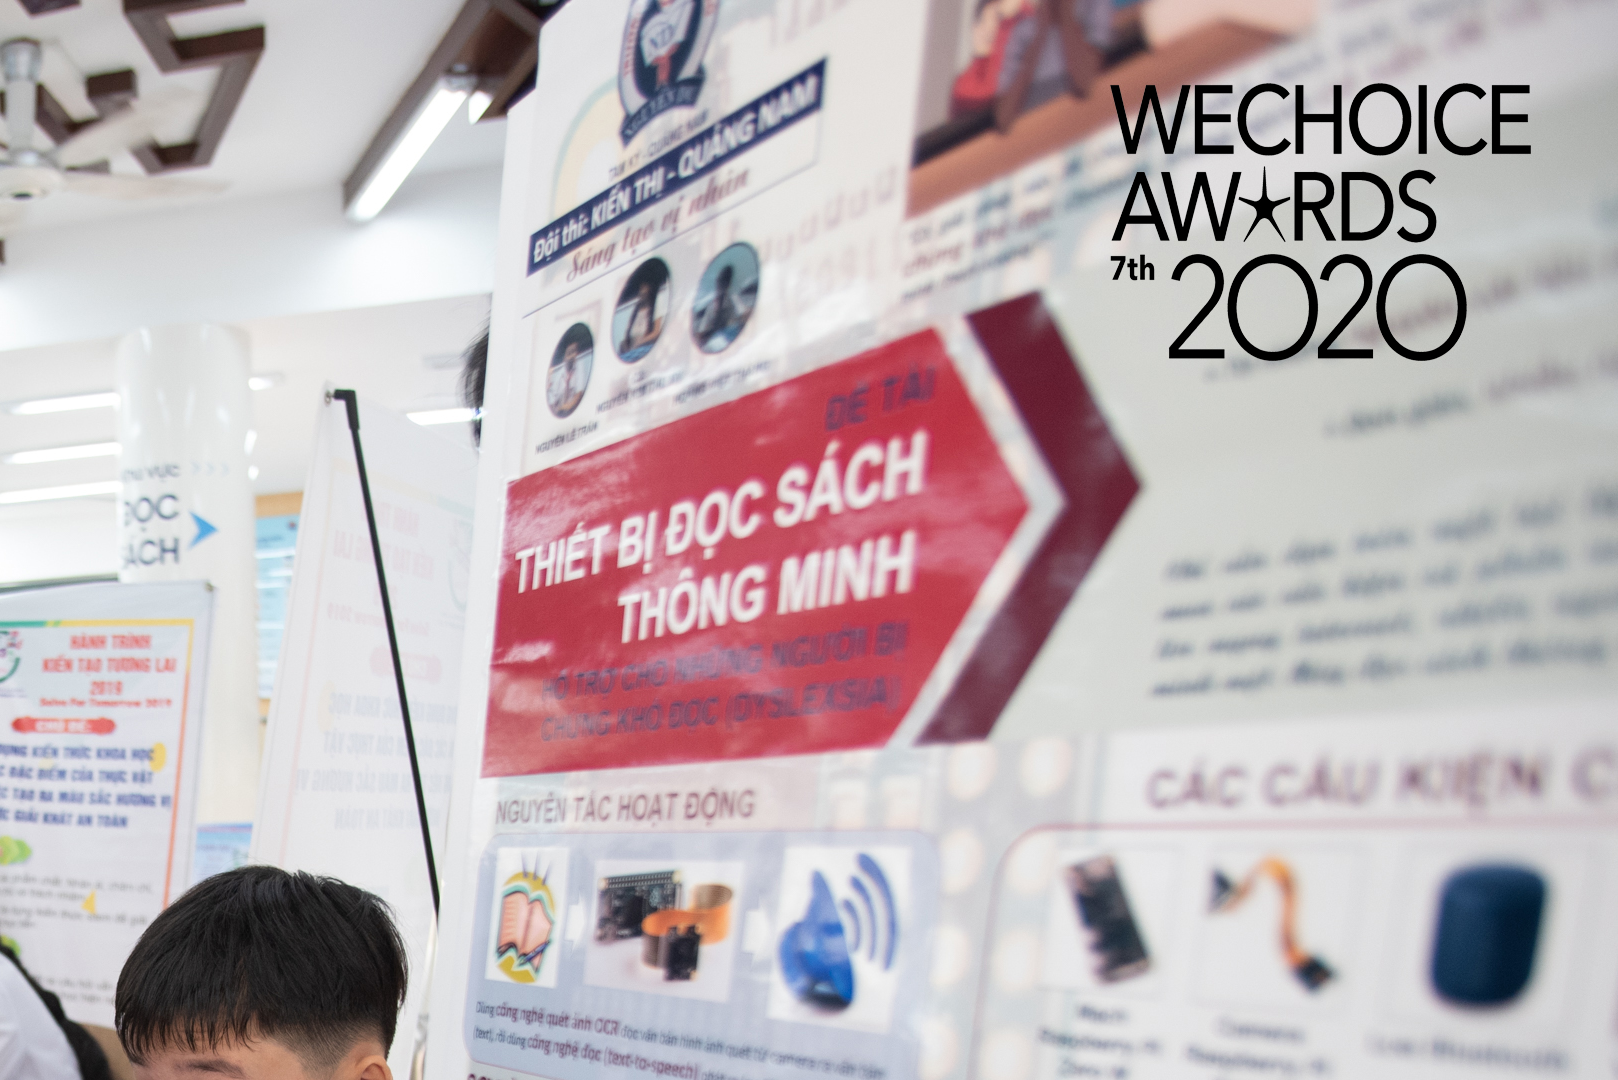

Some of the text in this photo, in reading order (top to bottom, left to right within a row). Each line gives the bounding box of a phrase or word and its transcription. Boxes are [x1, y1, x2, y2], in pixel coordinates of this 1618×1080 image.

[534, 232, 560, 264] Đội
[561, 213, 590, 247] thi:
[591, 183, 629, 231] KIẾN
[634, 167, 665, 197] THỊ
[677, 119, 756, 179] QUẢNG
[756, 75, 817, 133] NAM
[567, 242, 615, 282] Sáng
[514, 428, 931, 594] THIẾT BỊ ĐỌC SÁCH
[616, 529, 918, 645] THÔNG MINH
